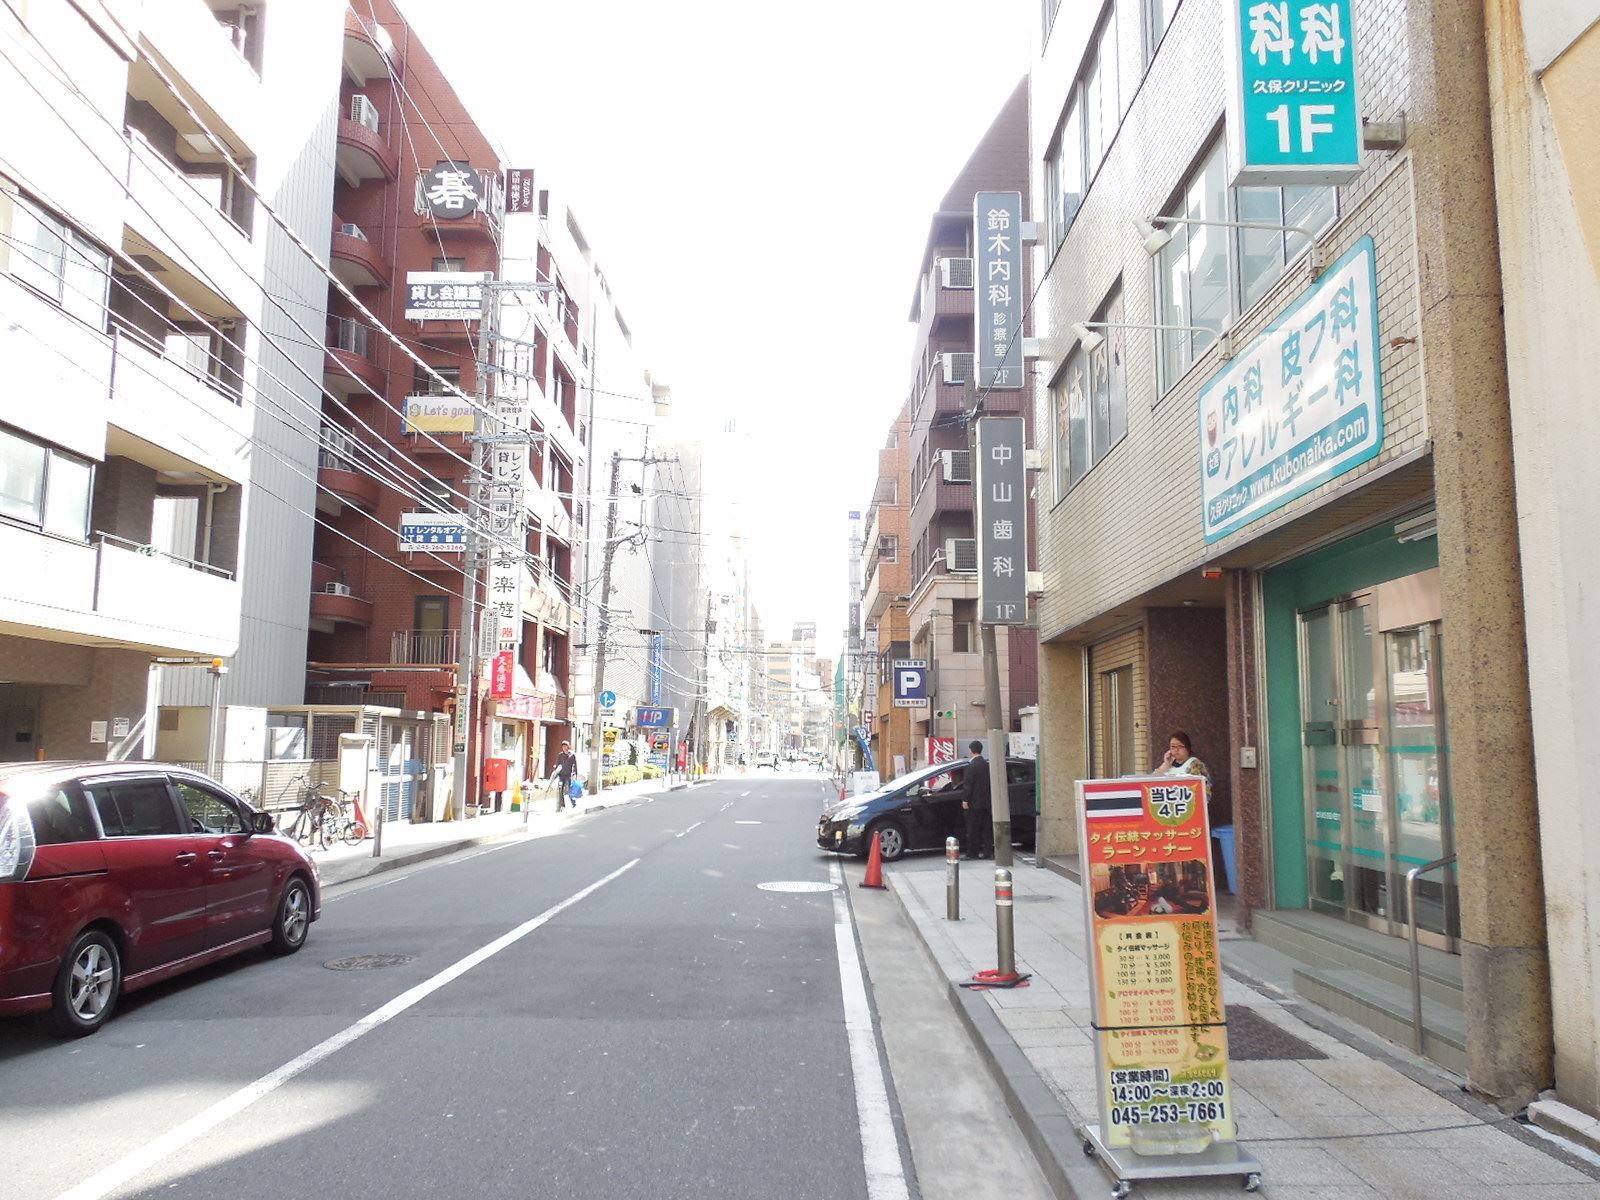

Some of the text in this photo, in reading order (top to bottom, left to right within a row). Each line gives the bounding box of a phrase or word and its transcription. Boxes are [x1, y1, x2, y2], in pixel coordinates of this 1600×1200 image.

[1253, 79, 1346, 94] 久保クリニック
[1266, 104, 1336, 153] 1F
[426, 170, 478, 210] 碁
[987, 208, 1012, 307] 鈴木内科
[993, 311, 1008, 358] 診療室
[1221, 276, 1359, 434] 内科 皮フ科
[994, 368, 1010, 384] 2F
[424, 405, 476, 418] Let's goal
[1222, 340, 1363, 481] アレルギー科
[1248, 414, 1366, 503] www.kubonaika.com
[992, 443, 1014, 578] 中山歯科
[1209, 486, 1249, 524] 久保クリニック
[995, 604, 1016, 620] 1F
[900, 671, 921, 695] P
[1151, 787, 1192, 803] 当ビル
[1159, 803, 1186, 817] 4F
[1090, 827, 1203, 844] タイ伝統マッサージ
[1102, 843, 1193, 859] ラーン・ナー
[1112, 1102, 1226, 1125] 045-253-7661
